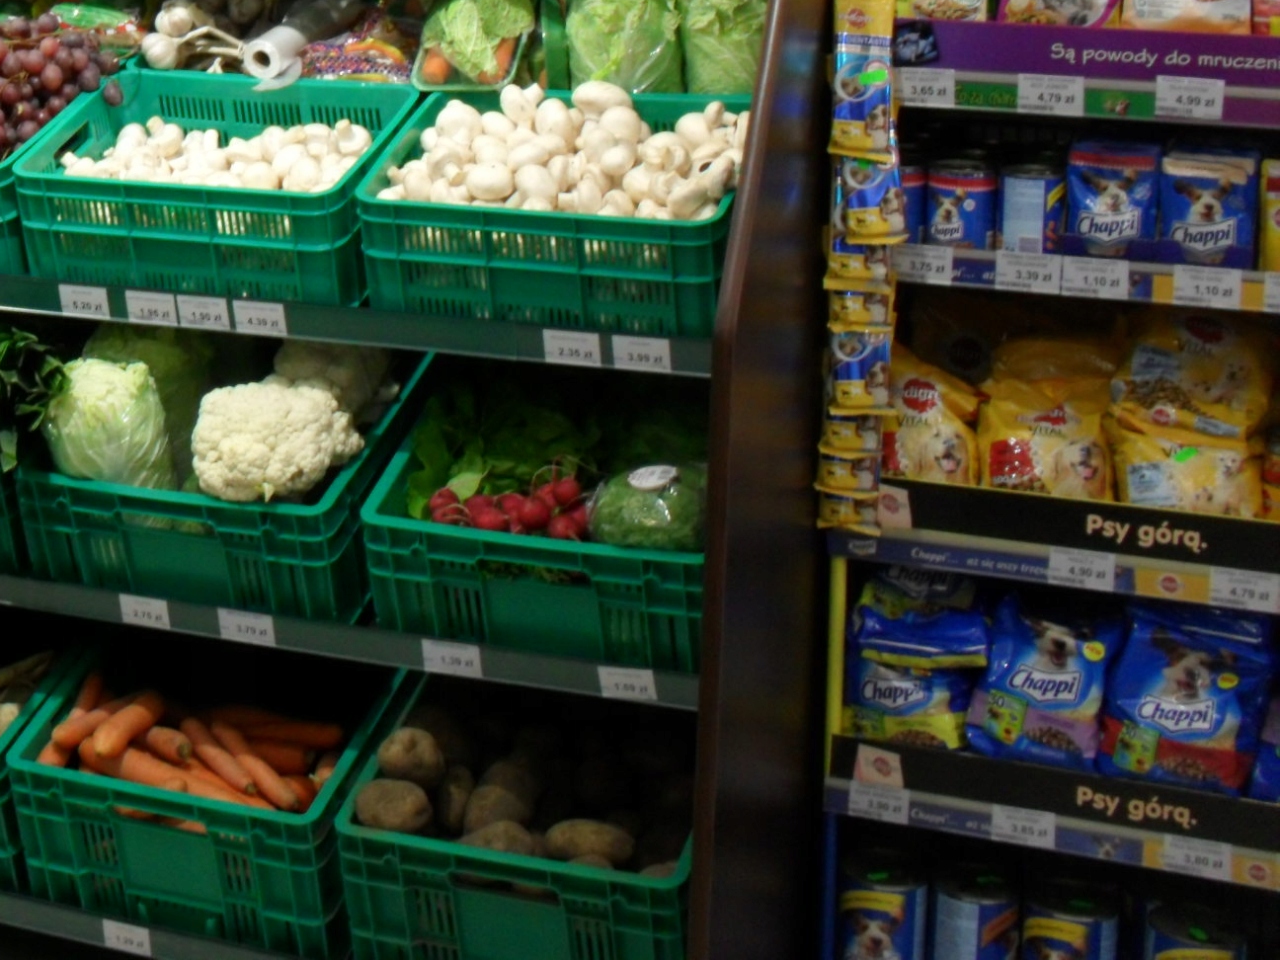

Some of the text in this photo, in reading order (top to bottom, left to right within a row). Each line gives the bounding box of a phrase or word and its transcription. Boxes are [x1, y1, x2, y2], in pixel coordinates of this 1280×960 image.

[1051, 43, 1075, 64] Są
[1083, 48, 1158, 68] powody
[1165, 50, 1191, 65] do
[1037, 92, 1062, 104] 4,79
[1176, 95, 1201, 107] 4,99
[1078, 215, 1135, 237] Chappi
[1170, 224, 1232, 247] Chappi
[1084, 276, 1107, 288] 1,10
[1194, 285, 1219, 297] 1,10
[1086, 514, 1208, 552] Psy górą.
[1008, 669, 1077, 696] Chappi
[1137, 700, 1211, 726] Chappi
[1076, 786, 1197, 830] Psy górą.
